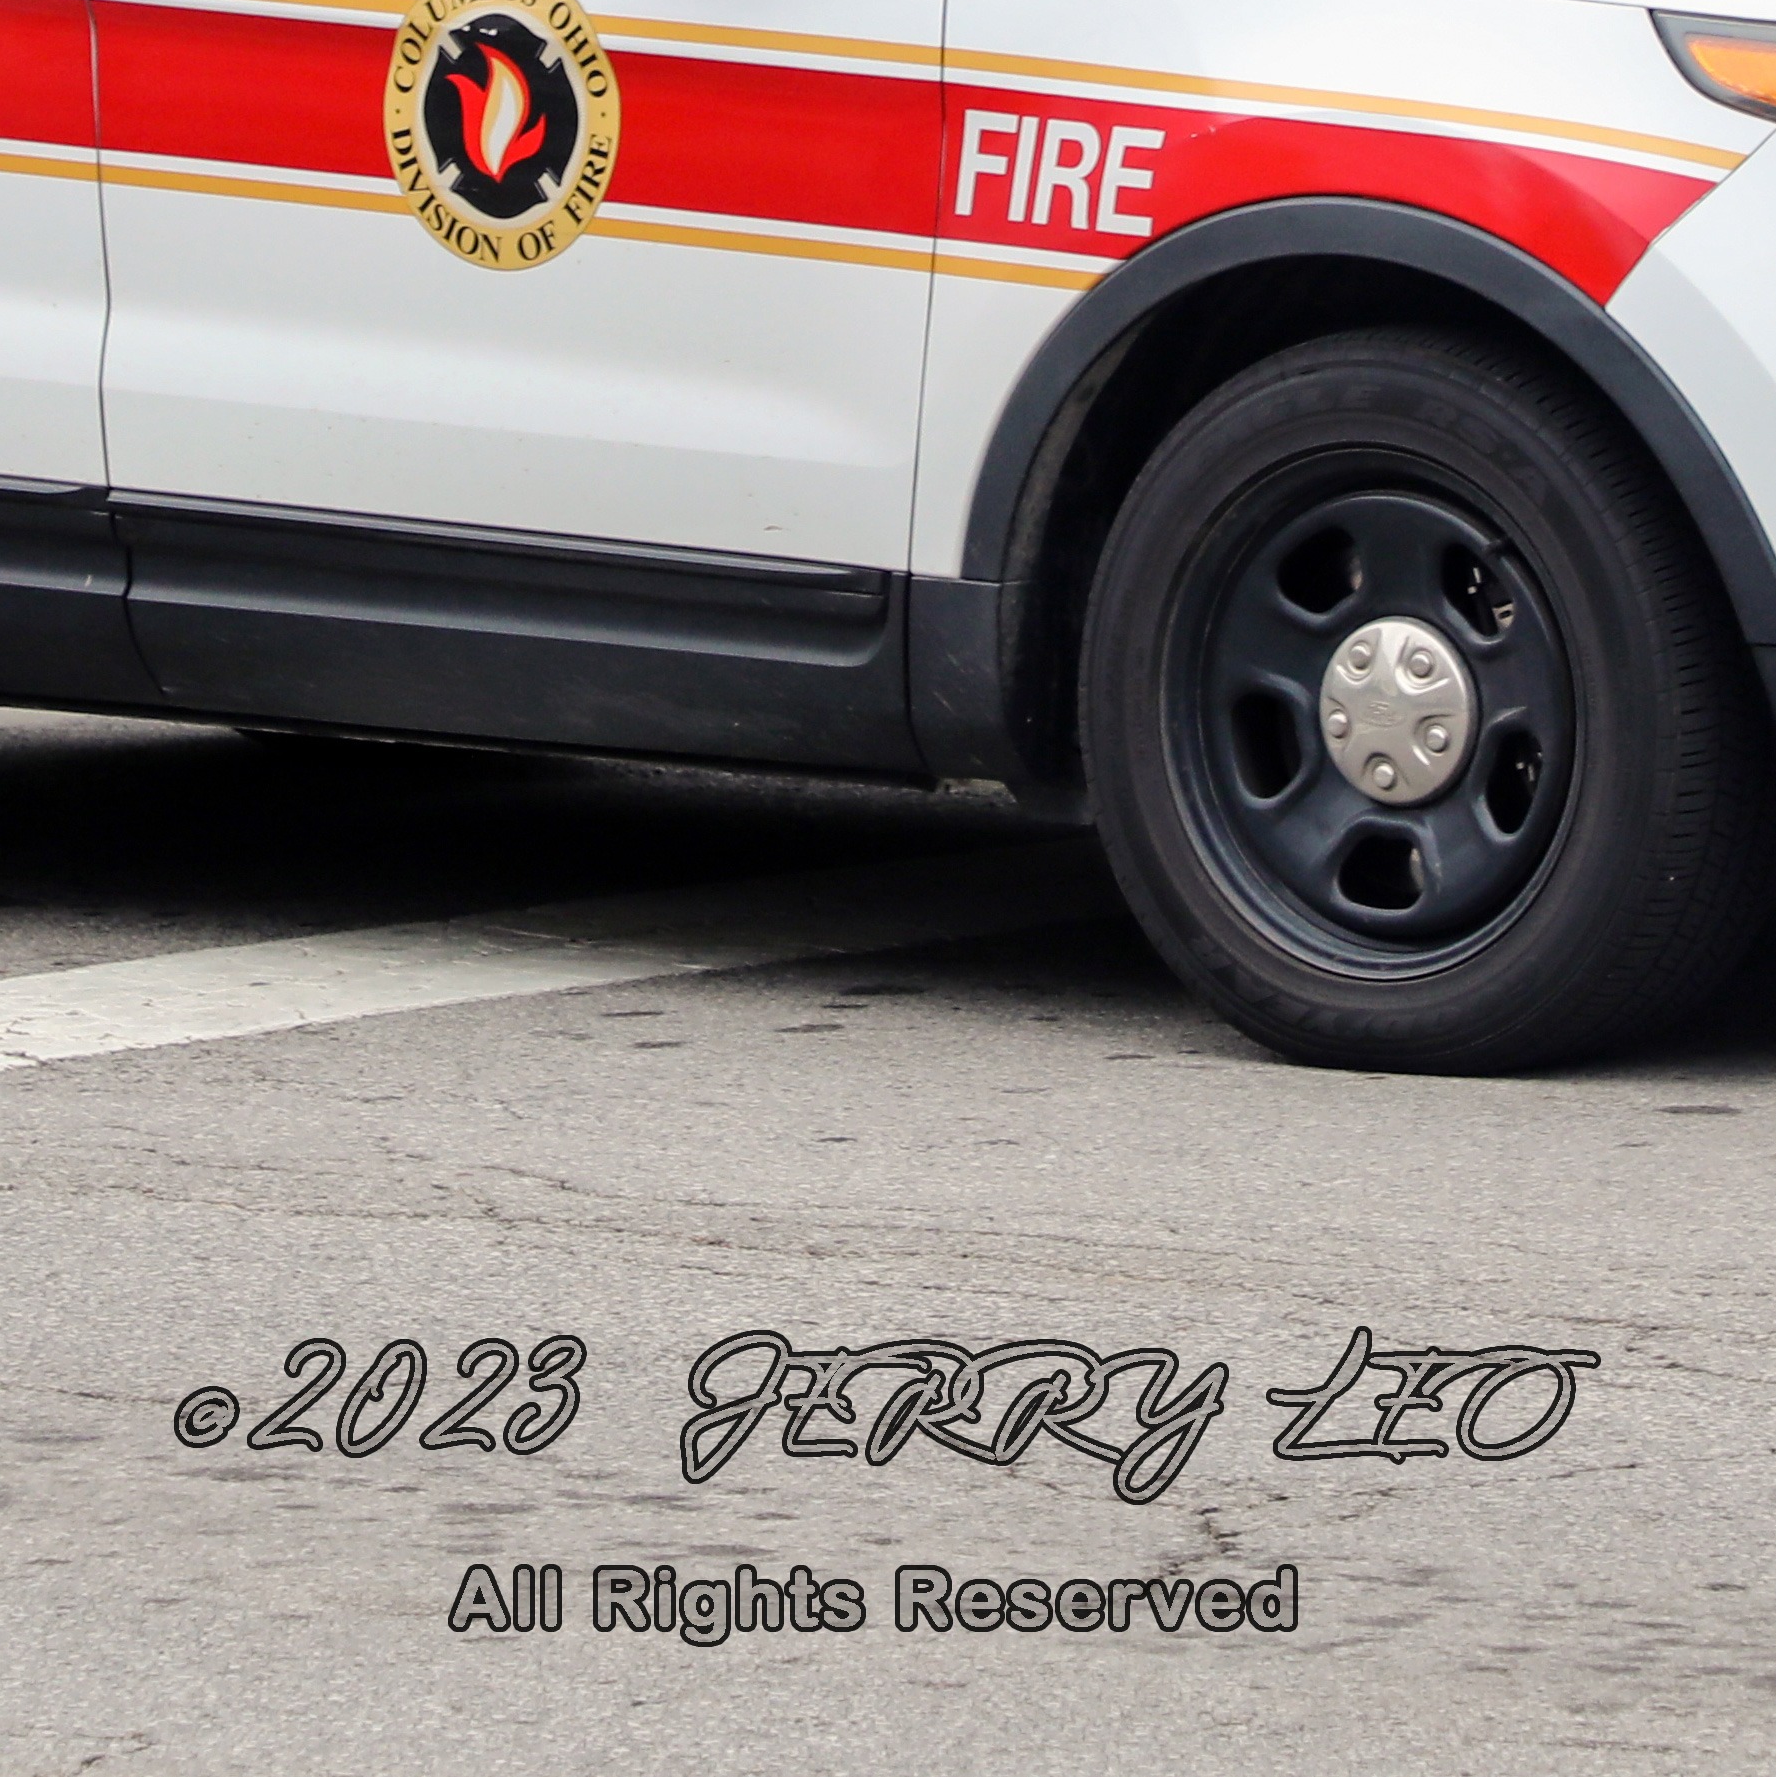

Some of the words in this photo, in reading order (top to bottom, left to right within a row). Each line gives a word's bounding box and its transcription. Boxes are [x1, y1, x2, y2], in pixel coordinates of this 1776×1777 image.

[549, 1, 609, 98] OHIO
[392, 128, 503, 262] DIVISION
[517, 220, 559, 261] OF
[564, 135, 613, 226] FIRE
[954, 108, 1165, 238] FIRE
